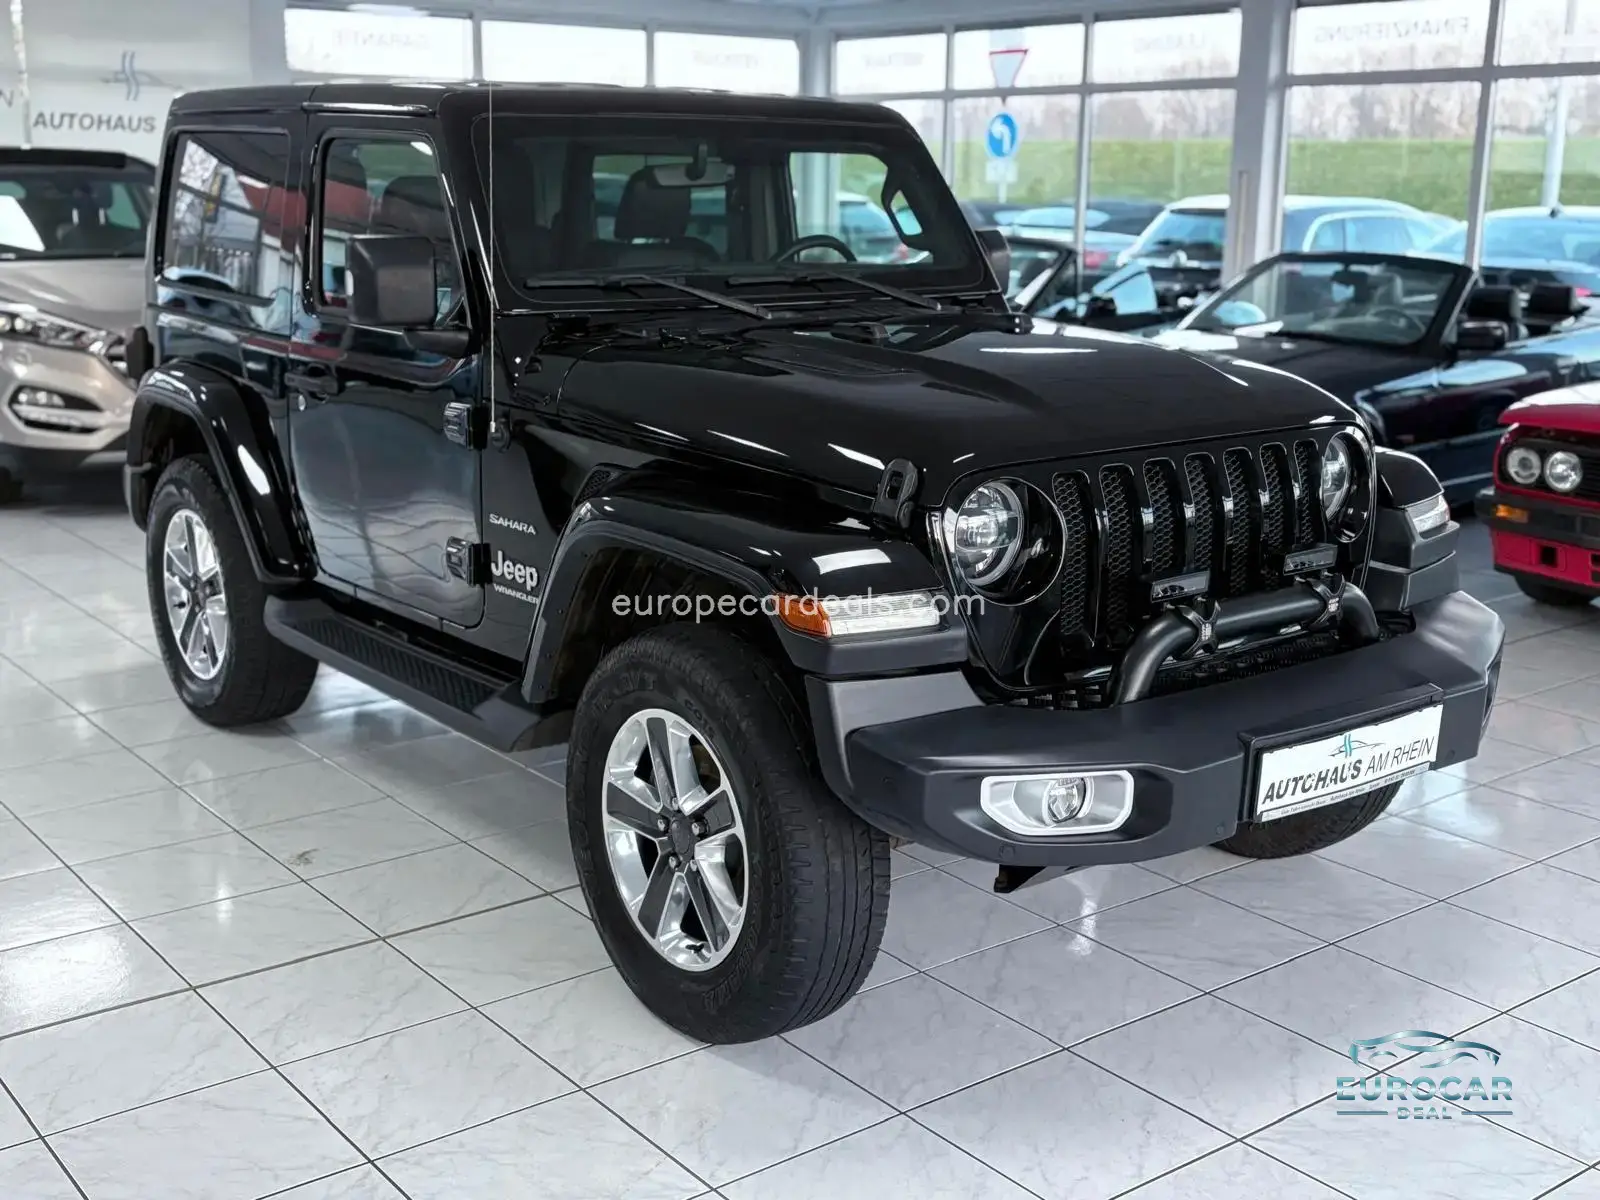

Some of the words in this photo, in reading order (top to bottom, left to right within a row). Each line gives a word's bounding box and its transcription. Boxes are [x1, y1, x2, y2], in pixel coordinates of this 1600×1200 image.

[33, 112, 156, 132] AUTOHAUS
[489, 513, 536, 535] SAHARA
[491, 550, 538, 591] Jeep
[1261, 758, 1363, 805] AUTOHAUS
[1364, 751, 1391, 776] AM
[1390, 736, 1435, 767] RHEIN
